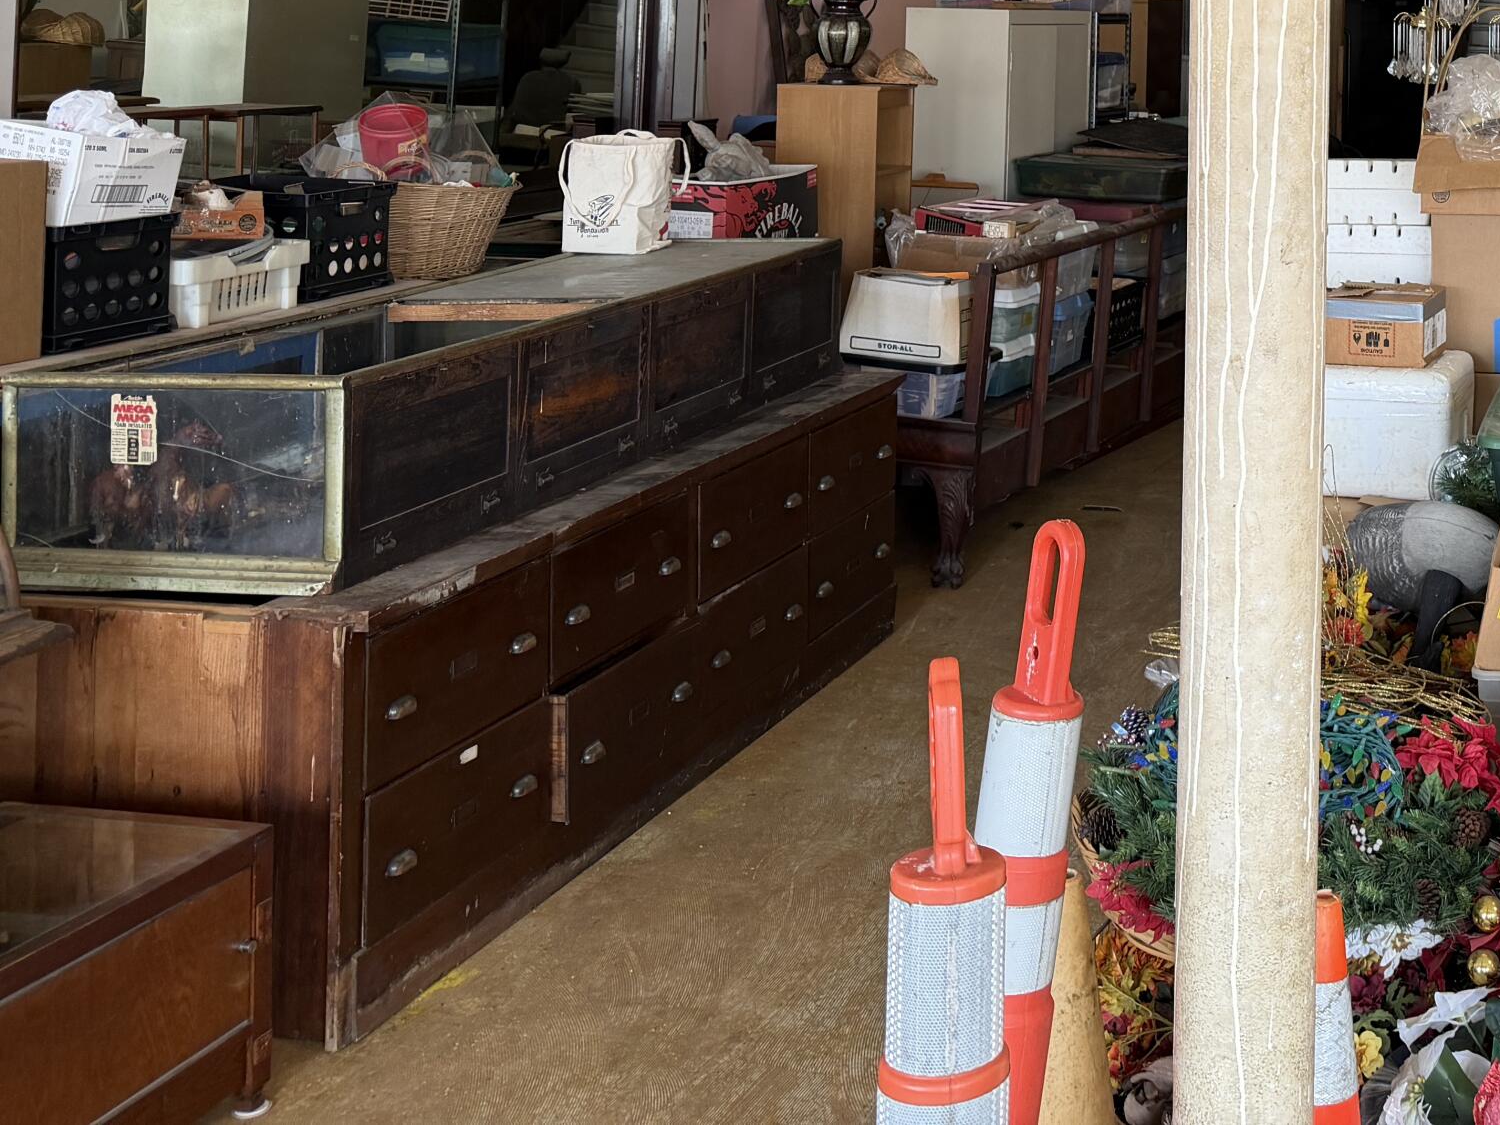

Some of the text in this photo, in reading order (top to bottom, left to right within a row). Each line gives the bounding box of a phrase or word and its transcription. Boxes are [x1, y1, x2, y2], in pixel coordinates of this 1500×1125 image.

[754, 202, 803, 239] FIREBALL
[877, 342, 914, 353] STOR-ALL
[113, 404, 154, 414] MEGA
[116, 414, 151, 423] MUG
